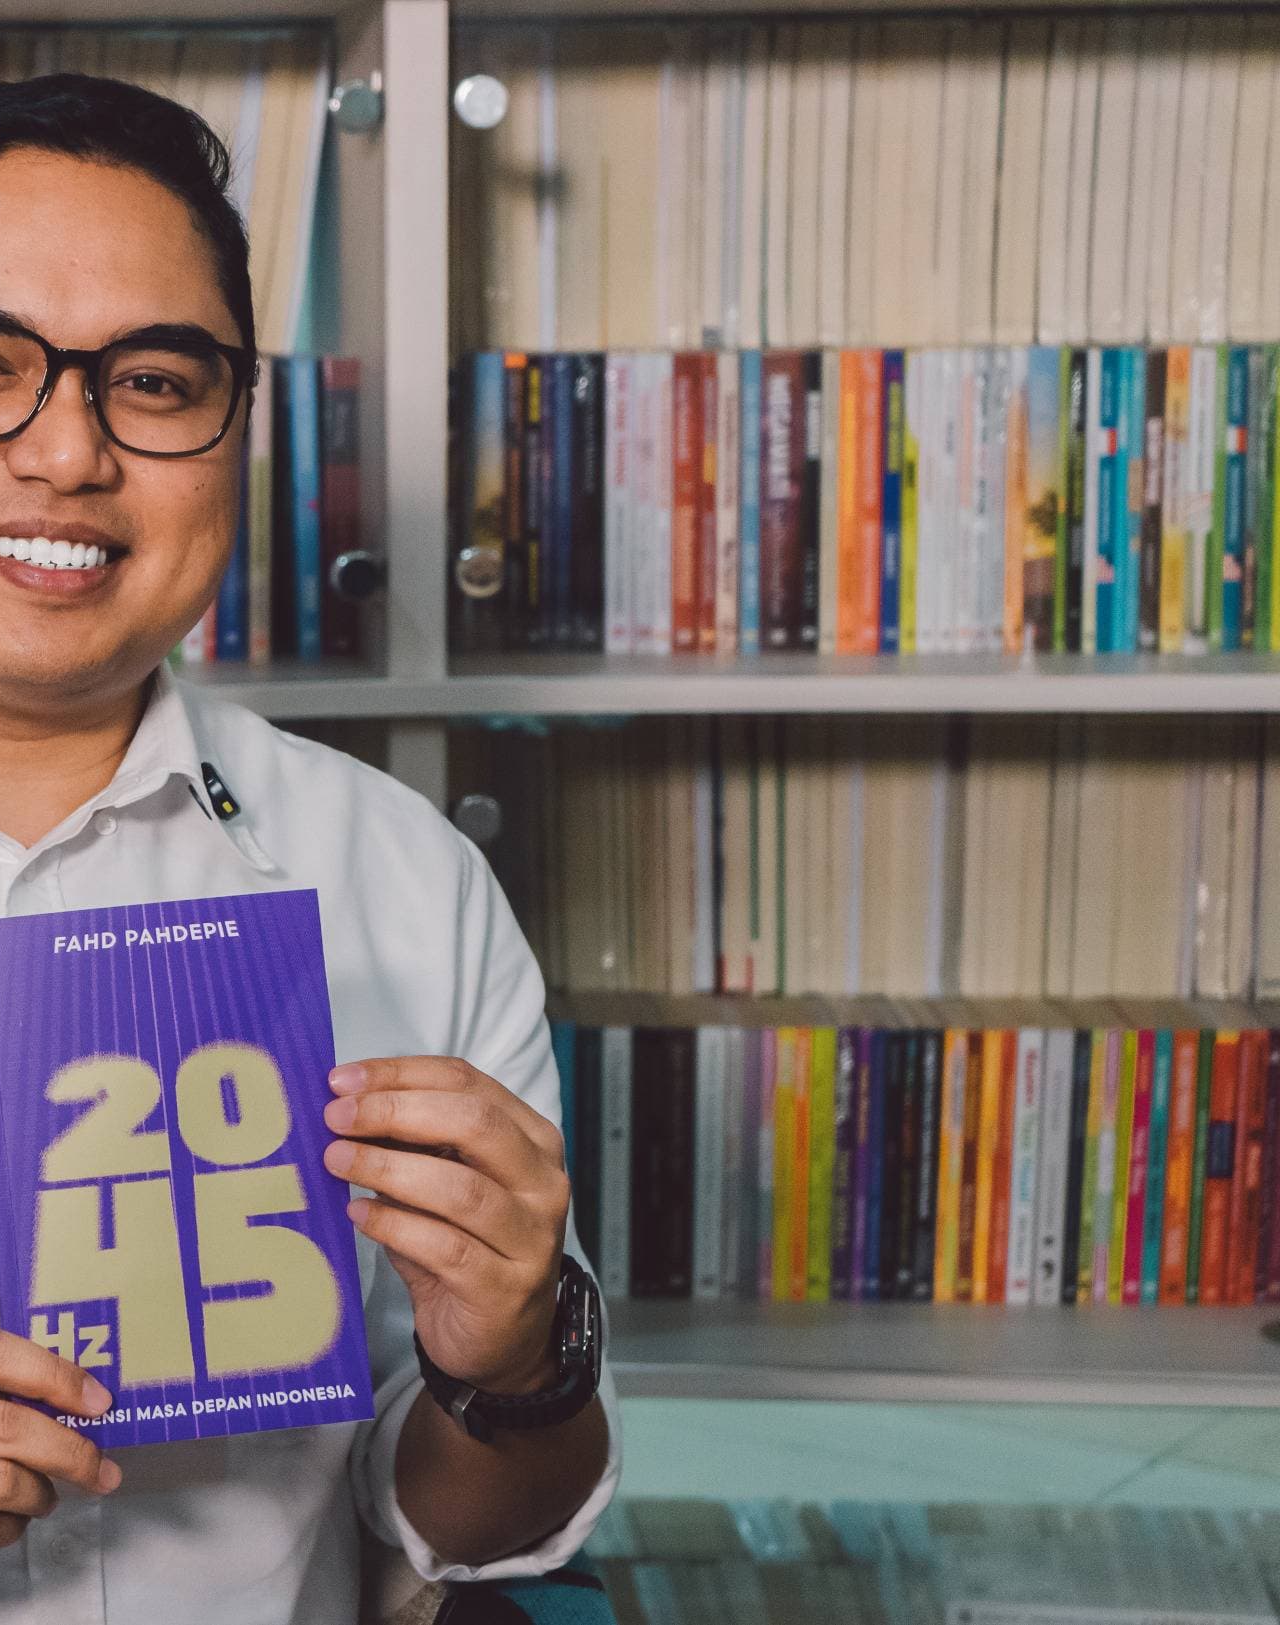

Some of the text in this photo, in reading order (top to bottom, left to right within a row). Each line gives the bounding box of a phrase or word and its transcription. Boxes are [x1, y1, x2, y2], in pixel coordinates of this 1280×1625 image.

[54, 920, 239, 953] FAHD PAHDEPIE
[41, 1039, 293, 1183] 20
[27, 1162, 345, 1391] 45
[31, 1311, 113, 1368] Hz
[136, 1402, 187, 1421] MASA
[192, 1395, 251, 1415] DEPAN
[256, 1383, 356, 1408] INDONESIA
